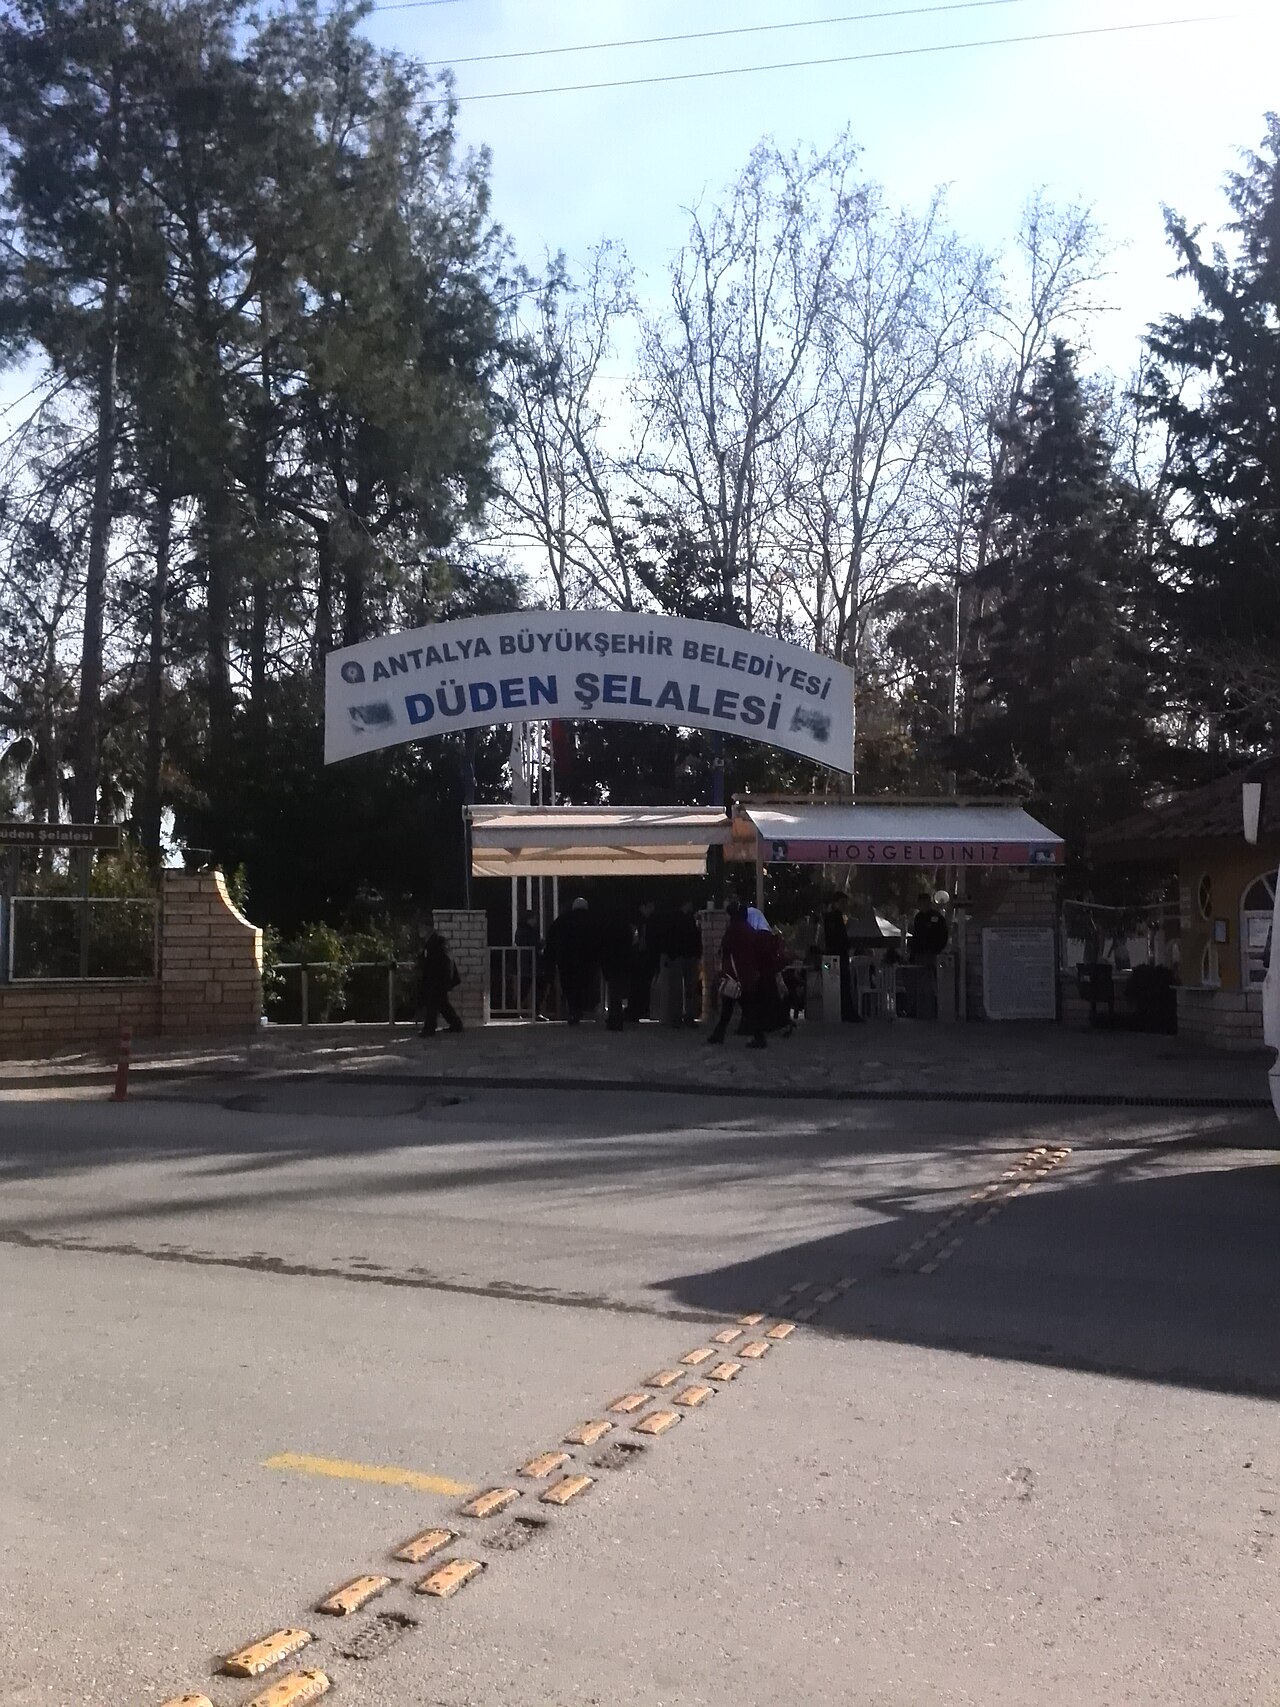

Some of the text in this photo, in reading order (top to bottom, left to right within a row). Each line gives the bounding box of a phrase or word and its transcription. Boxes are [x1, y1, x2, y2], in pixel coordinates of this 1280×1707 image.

[373, 628, 832, 700] ANTALYA BÜYÜKŞEHİR BELEDİYESİ
[404, 672, 782, 730] DÜDEN ŞELALESİ
[0, 829, 34, 839] üden
